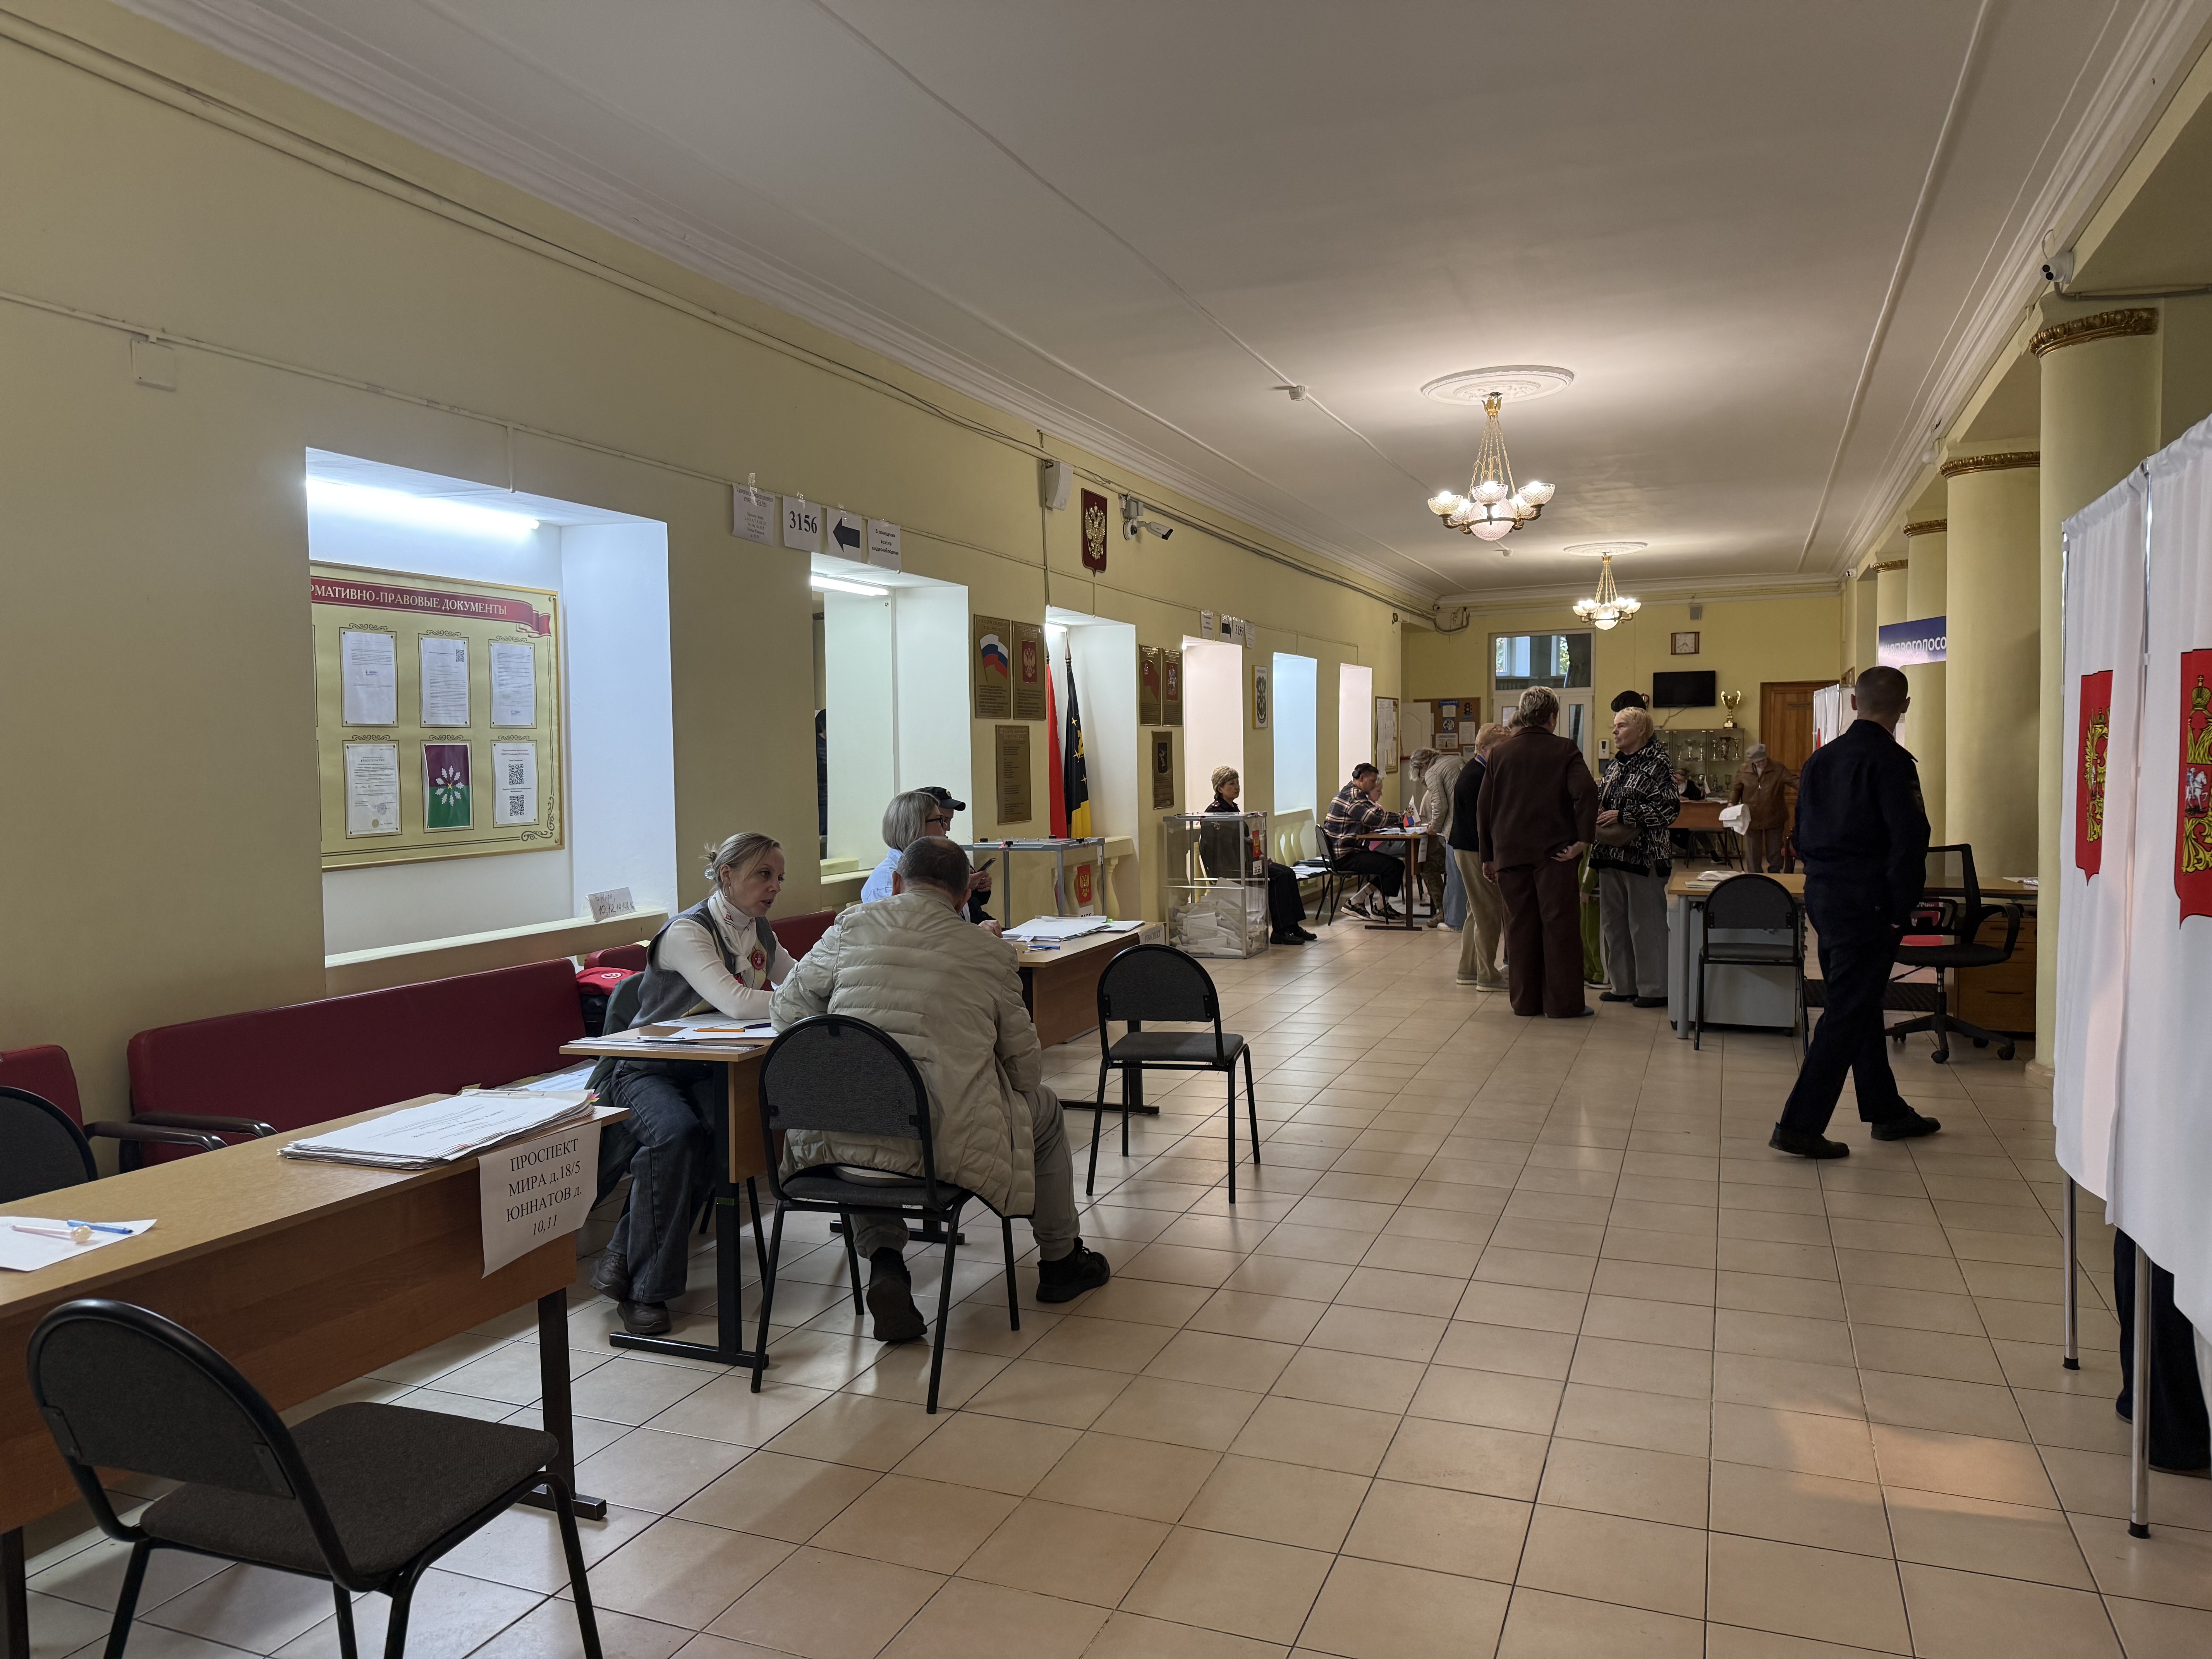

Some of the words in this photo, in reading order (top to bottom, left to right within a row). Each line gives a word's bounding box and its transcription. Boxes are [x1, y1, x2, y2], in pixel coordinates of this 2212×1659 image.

[789, 511, 817, 534] 3156
[442, 599, 507, 615] ДОКУМЕНТЫ
[510, 1138, 579, 1172] ПРОСПЕКТ
[509, 1173, 547, 1197] МИРА
[550, 1160, 580, 1185] д.18/5
[507, 1187, 571, 1223] ЮННАТОВ
[574, 1187, 582, 1199] д.
[533, 1214, 557, 1235] 10,11
